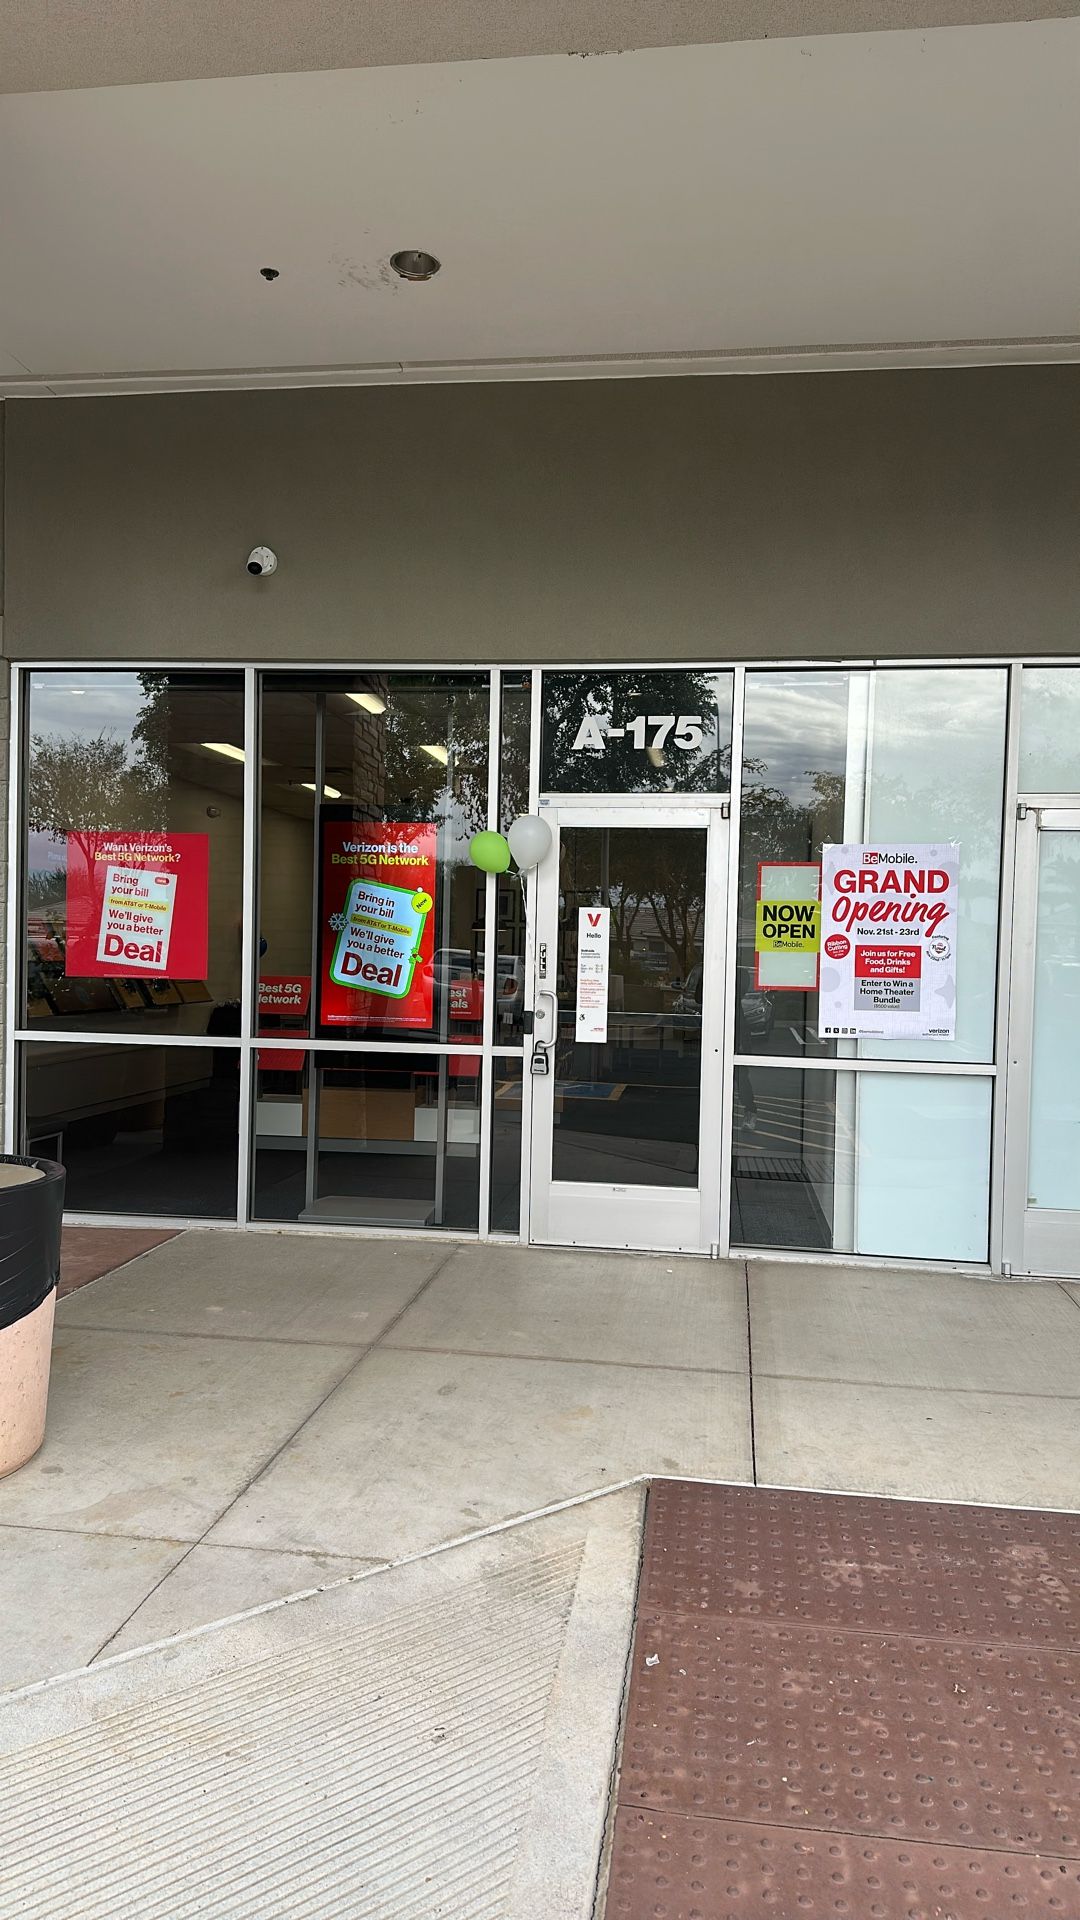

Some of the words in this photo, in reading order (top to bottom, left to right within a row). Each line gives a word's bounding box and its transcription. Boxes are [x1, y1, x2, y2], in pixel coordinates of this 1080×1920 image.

[571, 715, 704, 751] A-175
[104, 842, 128, 852] Want
[131, 843, 172, 852] Verizon's
[342, 842, 386, 853] Verizon
[388, 842, 397, 852] is
[399, 842, 418, 853] the
[95, 852, 116, 861] Best
[118, 853, 132, 861] 5G
[133, 853, 181, 862] Network?
[332, 854, 357, 865] Best
[359, 854, 376, 865] 5G
[378, 855, 429, 866] Network
[863, 852, 917, 864] BeMobile.
[113, 874, 138, 886] Bring
[833, 869, 950, 894] GRAND
[112, 886, 134, 895] your
[135, 887, 149, 897] bill
[358, 891, 384, 907] Bring
[385, 898, 394, 908] in
[416, 898, 427, 909] New
[144, 903, 166, 911] T-Mobile
[355, 904, 377, 916] your
[379, 906, 394, 918] bill
[762, 905, 815, 922] NOW
[109, 909, 132, 920] We'll
[133, 913, 153, 923] give
[832, 894, 949, 937] Opening
[107, 922, 126, 932] you
[133, 922, 163, 936] better
[388, 924, 410, 934] T-Mobile
[762, 924, 815, 938] OPEN
[350, 927, 373, 940] We'll
[374, 933, 394, 945] give
[104, 934, 162, 962] Deal
[347, 938, 366, 951] you
[374, 944, 404, 959] better
[341, 952, 402, 987] Deal
[258, 984, 283, 994] Best
[284, 984, 302, 994] 5G
[450, 988, 467, 998] est
[450, 998, 468, 1009] als
